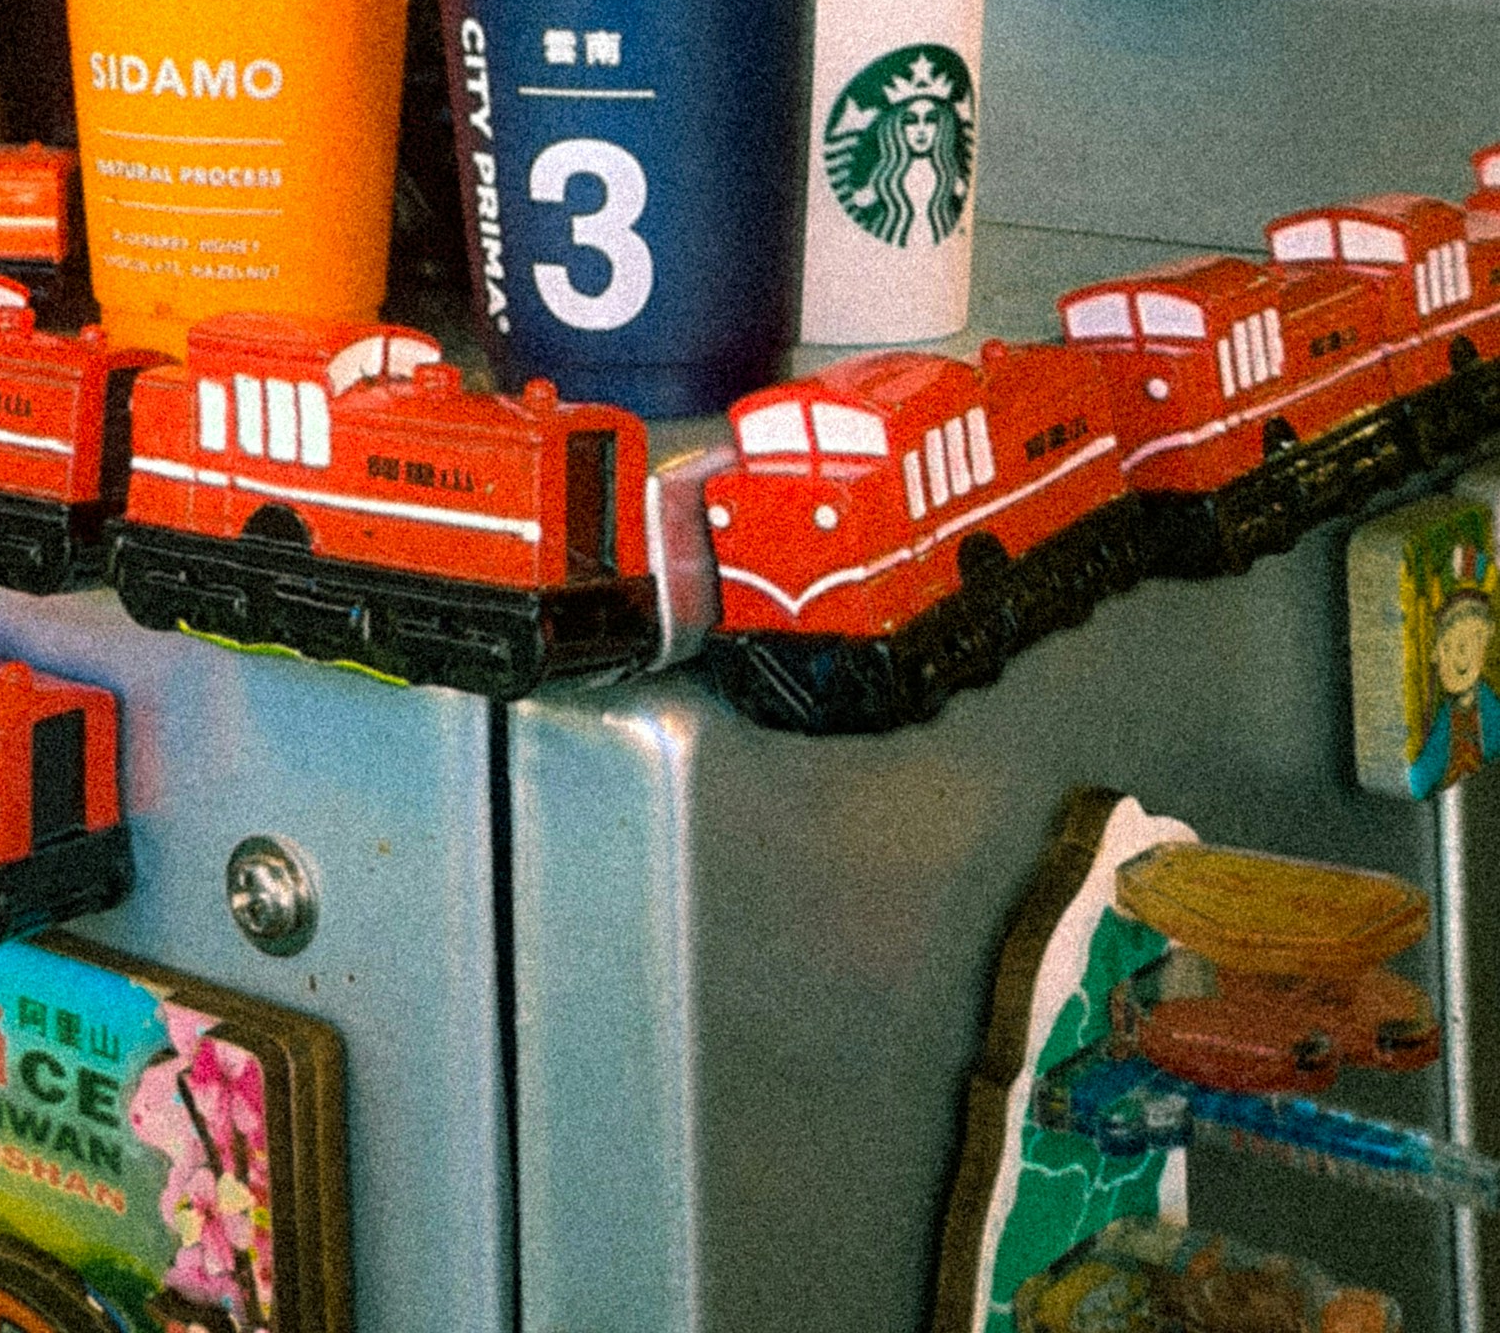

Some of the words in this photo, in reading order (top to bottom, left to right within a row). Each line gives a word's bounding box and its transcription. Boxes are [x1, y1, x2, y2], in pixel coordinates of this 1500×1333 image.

[89, 51, 284, 101] SIDAMO
[461, 17, 493, 140] CITY
[529, 138, 655, 331] 3
